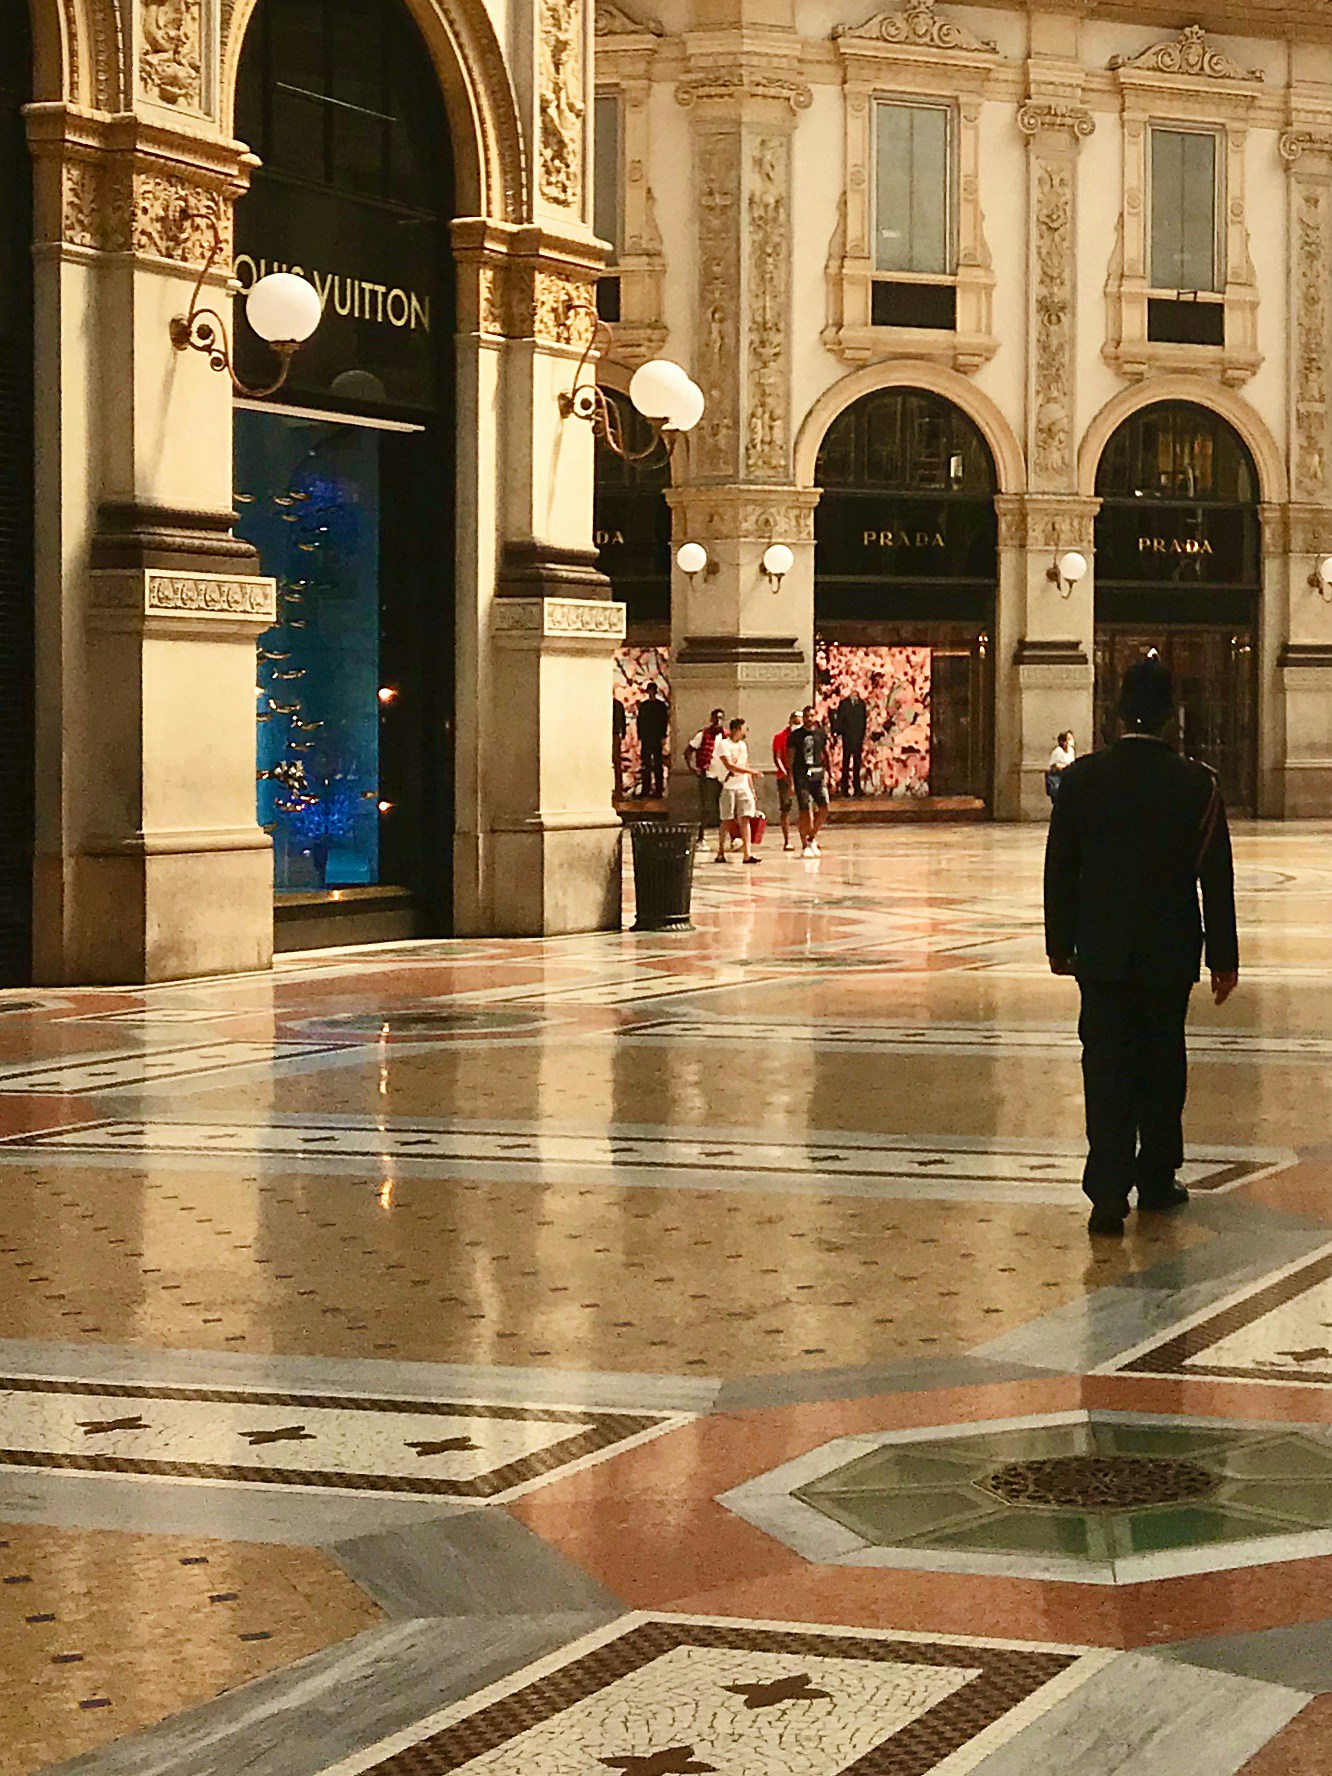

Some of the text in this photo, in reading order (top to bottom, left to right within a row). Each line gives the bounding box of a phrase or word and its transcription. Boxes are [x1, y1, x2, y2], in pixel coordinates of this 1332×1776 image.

[313, 270, 430, 333] VUITTON
[863, 530, 945, 546] PRADA
[1138, 537, 1213, 553] PRADA
